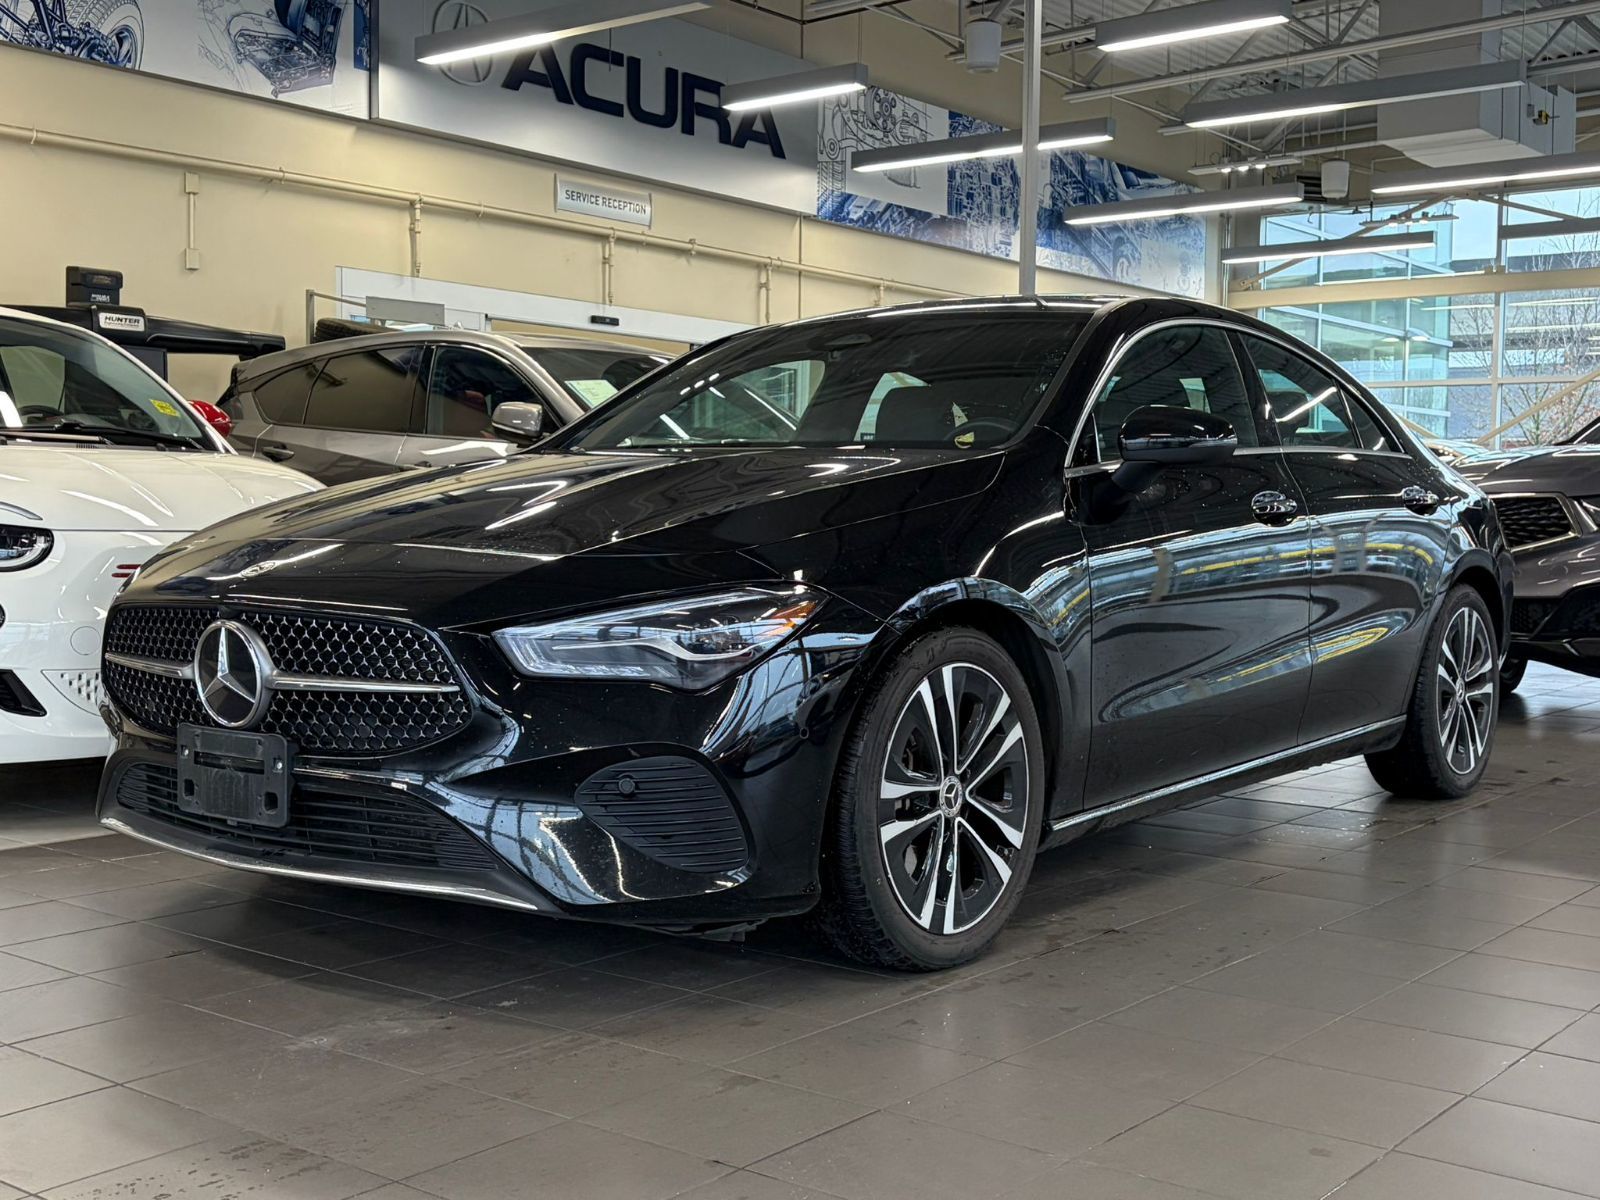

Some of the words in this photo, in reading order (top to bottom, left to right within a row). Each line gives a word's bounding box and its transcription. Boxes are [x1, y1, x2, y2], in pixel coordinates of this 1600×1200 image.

[501, 42, 786, 159] ACURA
[565, 189, 600, 206] SERVICE
[601, 196, 646, 215] RECEPTION
[104, 315, 141, 324] HUNTER
